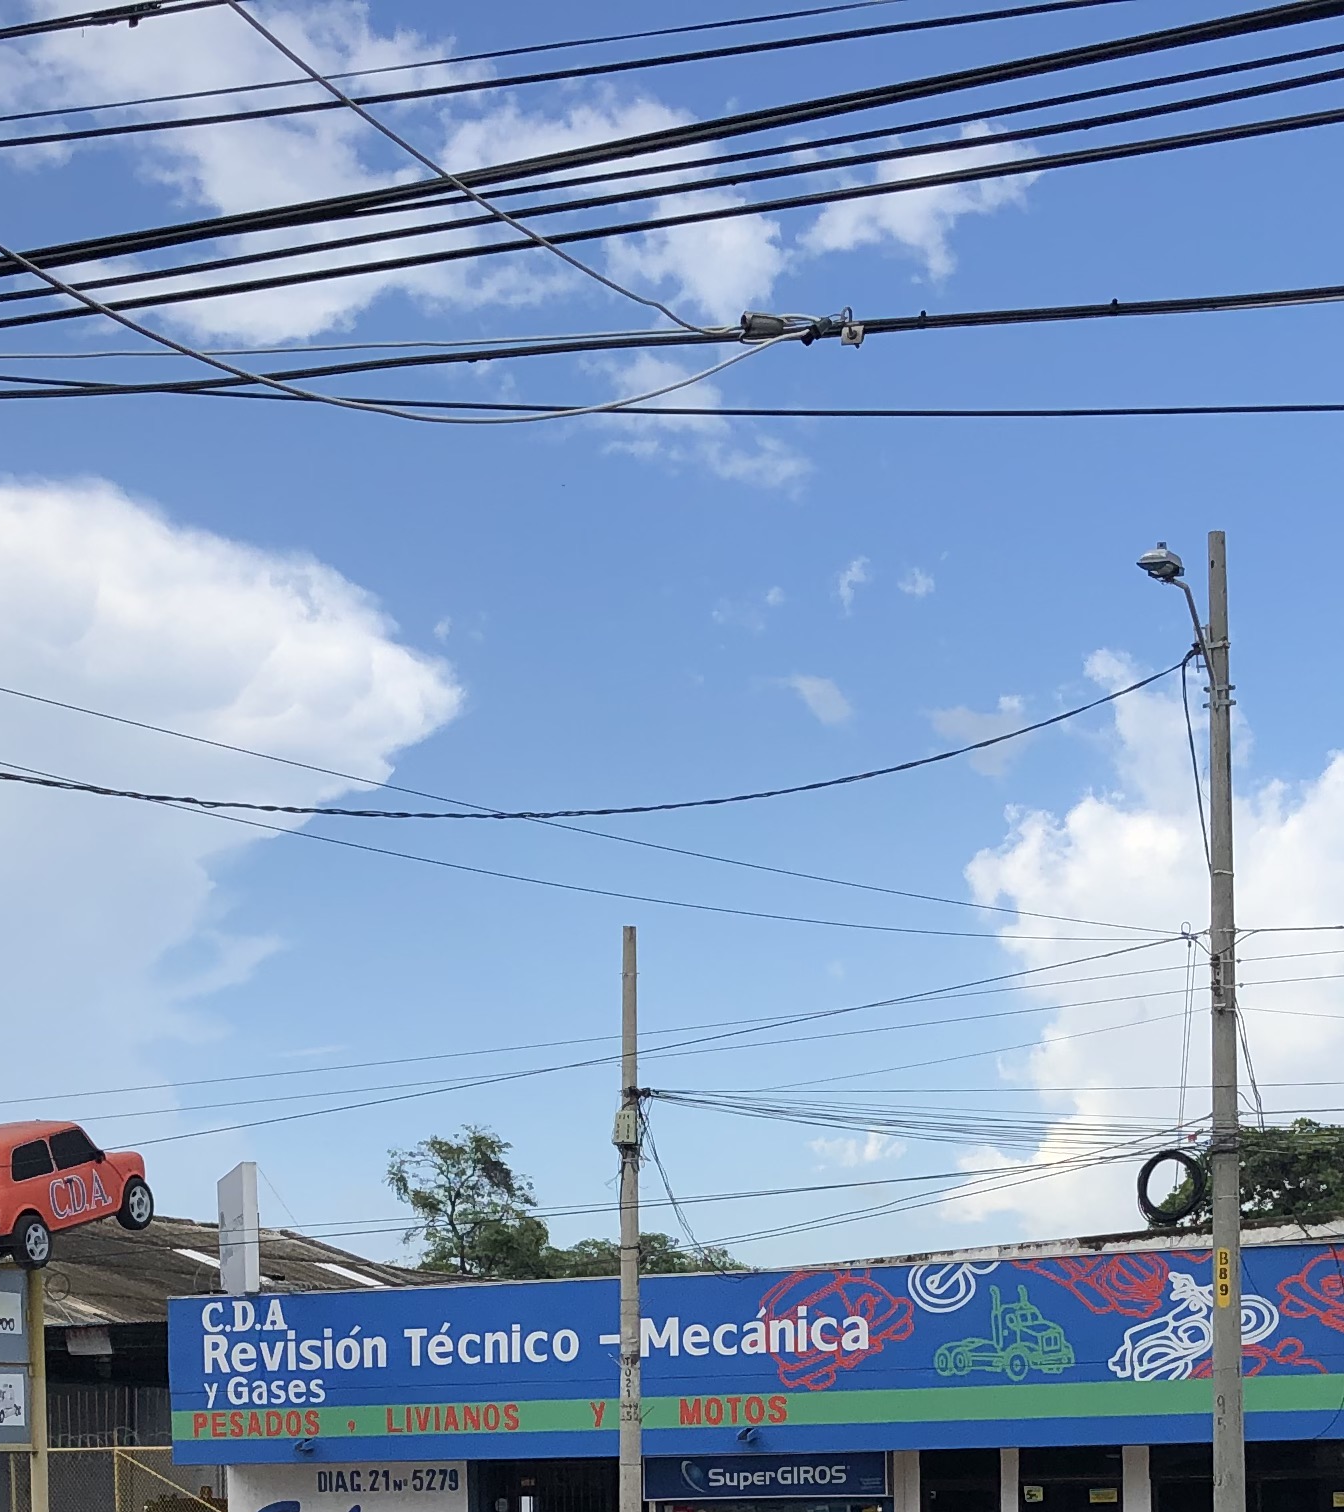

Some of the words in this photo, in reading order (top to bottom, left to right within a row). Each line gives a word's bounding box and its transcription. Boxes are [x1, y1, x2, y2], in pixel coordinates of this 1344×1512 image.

[202, 1299, 288, 1334] C.D.A
[204, 1325, 386, 1374] Revisión
[404, 1322, 579, 1368] Técnico
[640, 1305, 869, 1358] Mecánica
[204, 1382, 218, 1408] y
[227, 1376, 326, 1405] Gases
[193, 1410, 320, 1439] PESADOS
[386, 1404, 520, 1433] LIVIANOS
[591, 1401, 606, 1428] Y
[679, 1396, 788, 1427] MOTOS
[412, 1469, 459, 1492] 5279
[708, 1466, 847, 1490] SuperGIROS
